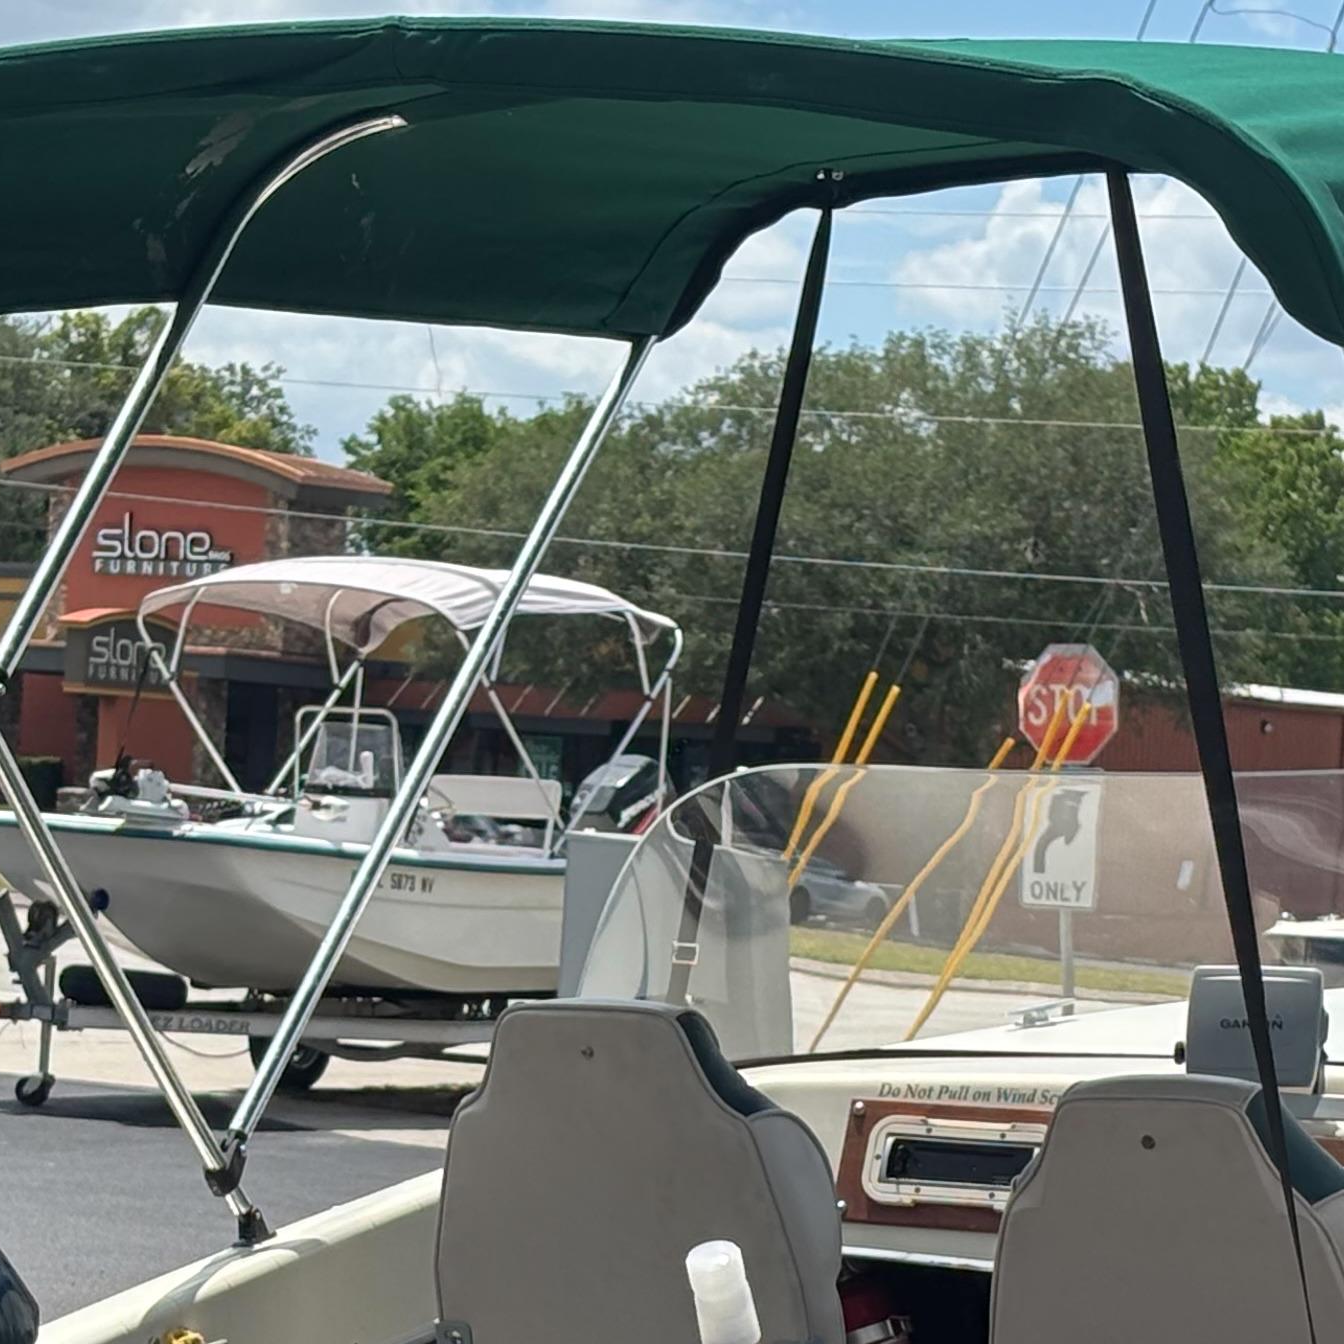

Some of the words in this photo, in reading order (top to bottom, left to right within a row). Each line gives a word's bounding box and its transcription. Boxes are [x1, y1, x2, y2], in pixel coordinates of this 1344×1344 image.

[92, 511, 210, 560] slone
[1030, 880, 1087, 901] ONLY
[878, 1082, 901, 1098] Do
[904, 1083, 934, 1099] Not
[937, 1085, 970, 1101] Pull
[972, 1090, 992, 1102] on
[996, 1087, 1037, 1104] Wind
